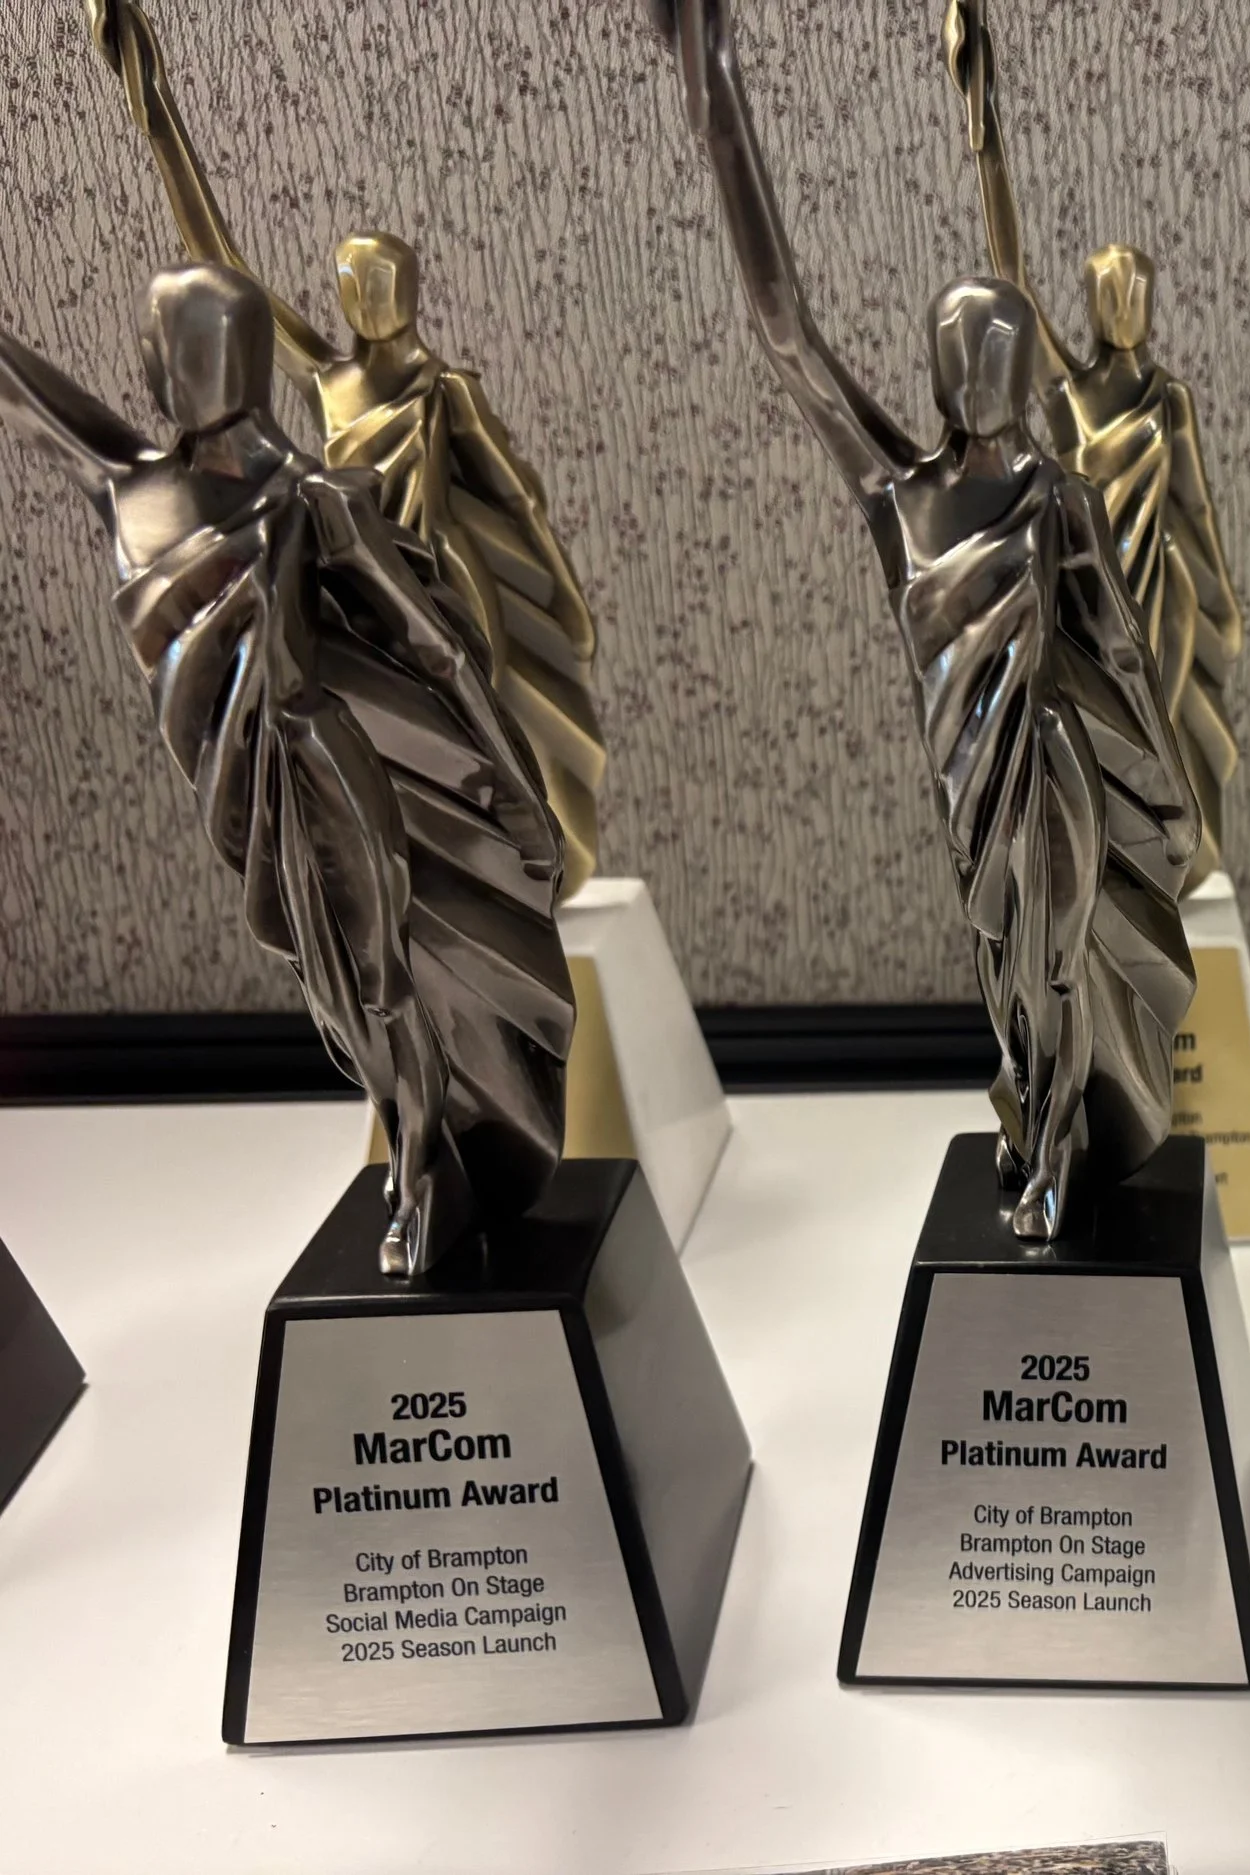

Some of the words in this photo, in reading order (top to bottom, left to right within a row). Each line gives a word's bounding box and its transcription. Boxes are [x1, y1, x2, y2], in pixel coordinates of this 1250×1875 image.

[1173, 1064, 1202, 1083] ard
[1020, 1354, 1090, 1381] 2025
[390, 1392, 467, 1420] 2025
[983, 1390, 1127, 1424] MarCom
[353, 1428, 512, 1465] MarCom
[941, 1439, 1067, 1468] Platinum
[1076, 1442, 1167, 1469] Award
[312, 1484, 451, 1514] Platinum
[461, 1476, 559, 1507] Award
[974, 1504, 1010, 1527] City
[1016, 1506, 1035, 1524] of
[1040, 1507, 1132, 1530] Brampton
[960, 1533, 1052, 1556] Brampton
[1059, 1535, 1084, 1554] On
[1091, 1536, 1146, 1558] Stage
[356, 1552, 394, 1574] City
[401, 1550, 421, 1570] of
[428, 1546, 528, 1570] Brampton
[949, 1562, 1054, 1585] Advertising
[1061, 1563, 1155, 1587] Campaign
[344, 1580, 444, 1604] Brampton
[452, 1577, 480, 1596] On
[486, 1575, 544, 1597] Stage
[953, 1590, 1001, 1608] 2025
[1008, 1591, 1076, 1610] Season
[1083, 1592, 1151, 1612] Launch
[326, 1611, 388, 1634] Social
[395, 1608, 458, 1630] Media
[464, 1603, 566, 1626] Campaign
[342, 1641, 394, 1662] 2025
[401, 1638, 476, 1658] Season
[482, 1632, 556, 1654] Launch
